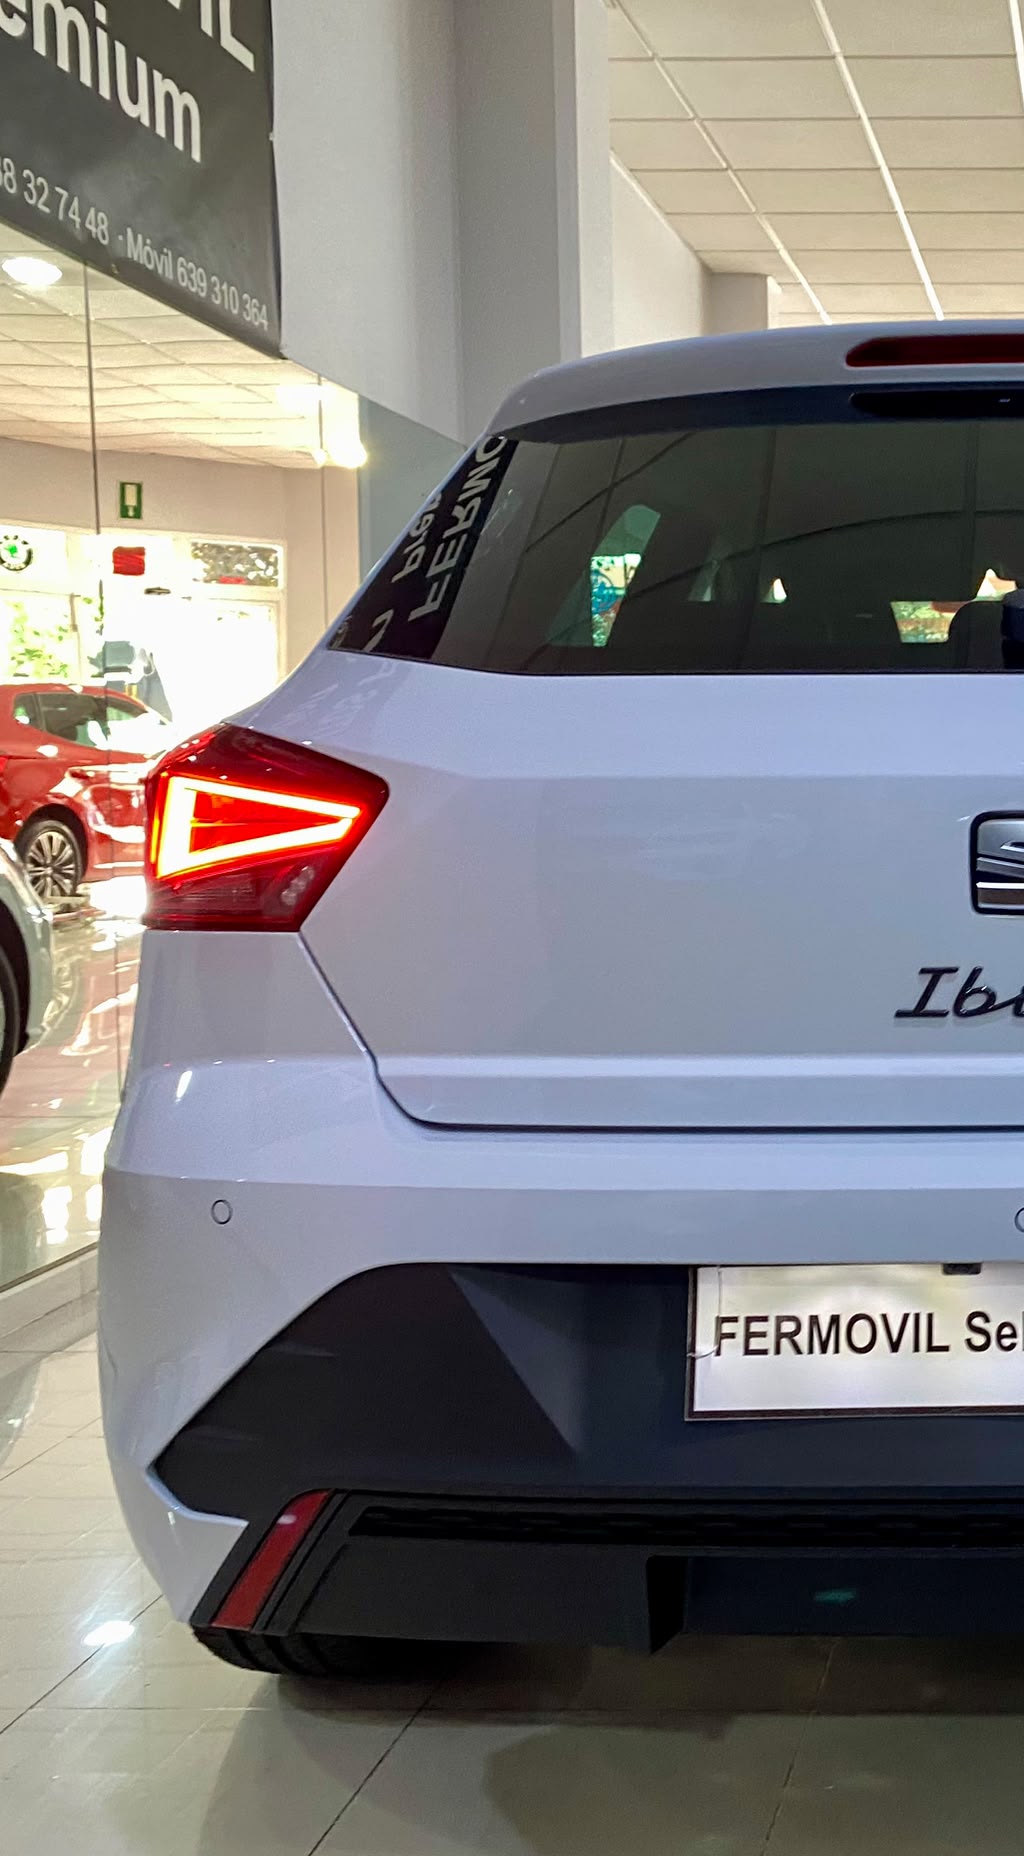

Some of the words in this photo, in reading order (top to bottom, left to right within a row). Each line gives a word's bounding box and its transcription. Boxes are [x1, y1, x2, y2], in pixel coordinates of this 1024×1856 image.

[22, 169, 50, 213] 32
[55, 187, 81, 229] 74
[85, 207, 109, 245] 48
[177, 257, 207, 299] 639
[211, 276, 239, 315] 310
[242, 293, 268, 331] 364
[715, 1312, 950, 1356] FERMOVIL
